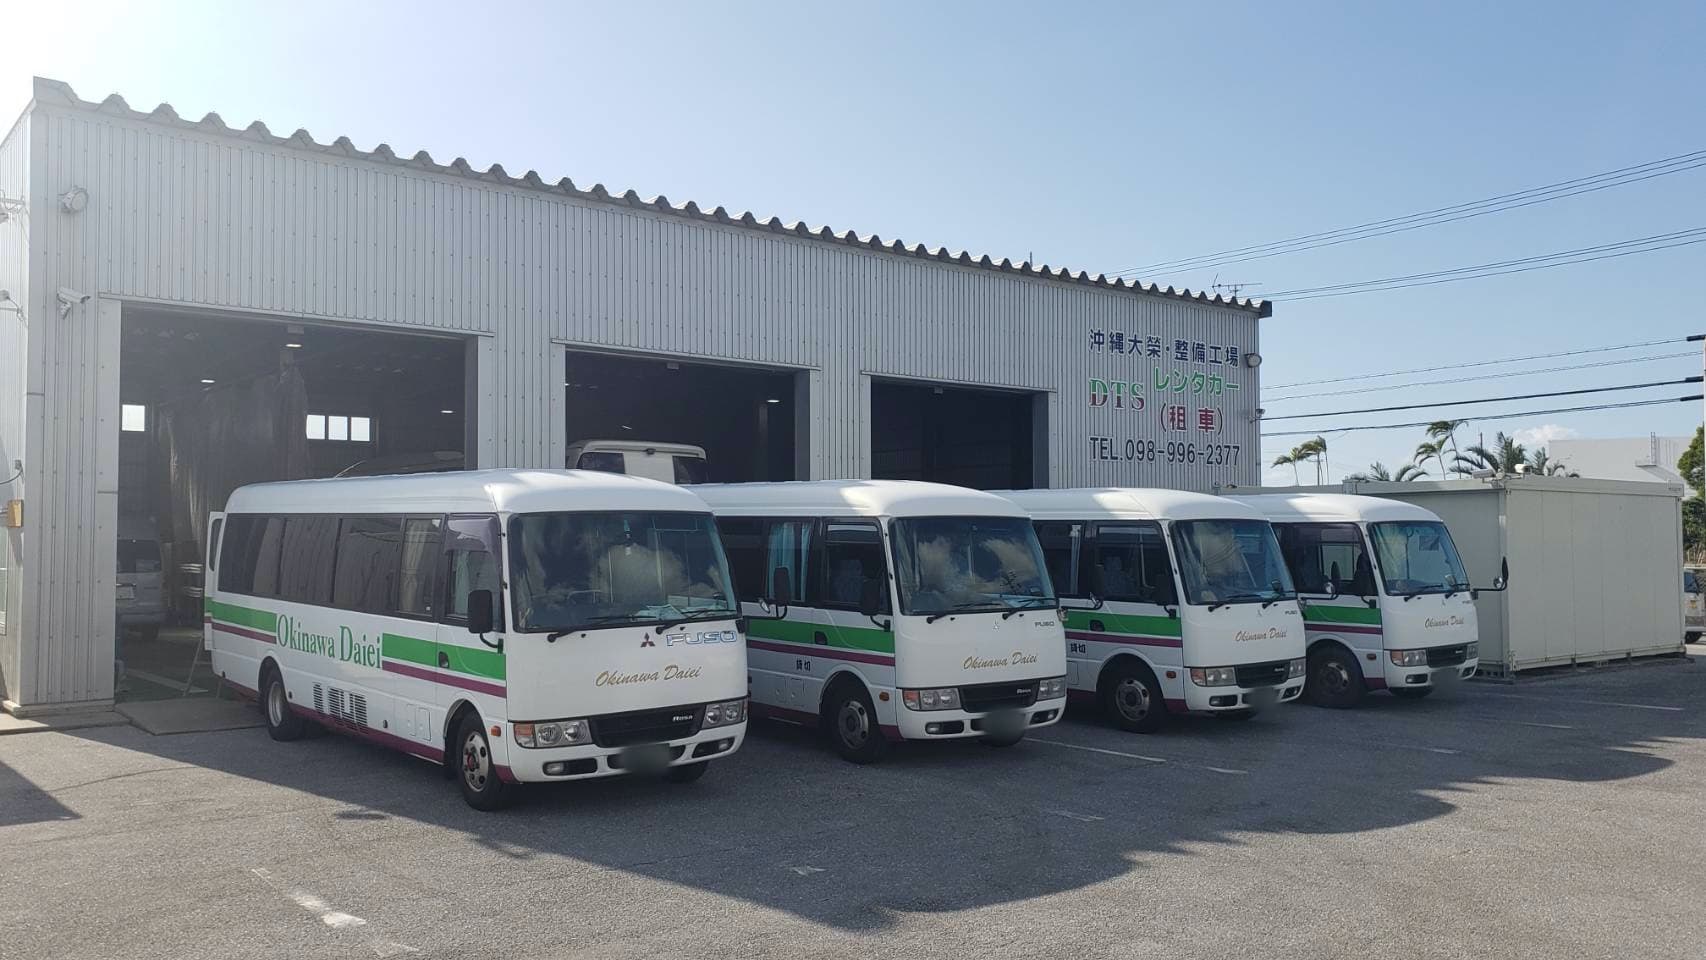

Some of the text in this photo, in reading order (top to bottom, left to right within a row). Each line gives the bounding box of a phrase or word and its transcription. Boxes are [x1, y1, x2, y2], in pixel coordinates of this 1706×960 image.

[1089, 379, 1145, 410] DTS
[1154, 367, 1240, 396] レンタカー
[276, 614, 380, 668] Okinawa Daiei
[666, 630, 737, 646] FUSO
[963, 651, 1037, 669] Okinawa Daiei
[595, 664, 702, 687] Okinawa Daiei
